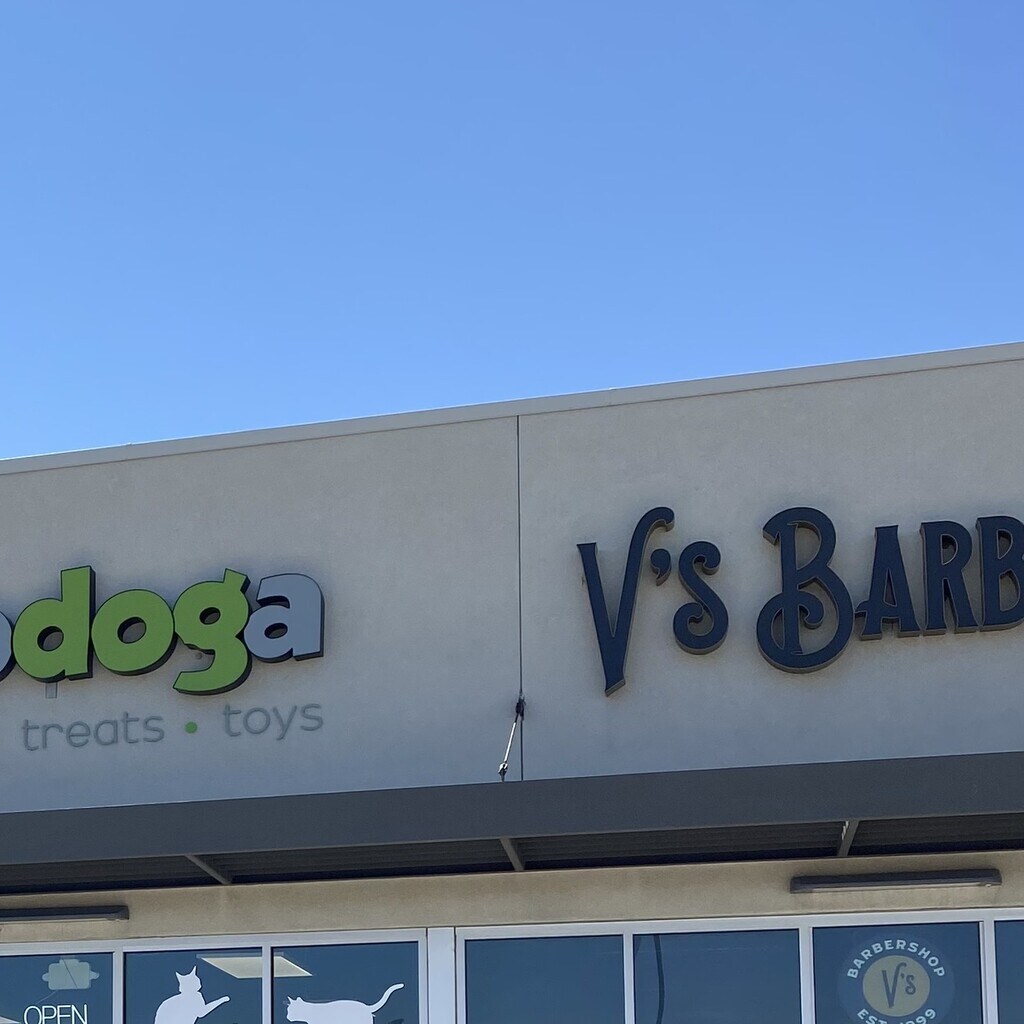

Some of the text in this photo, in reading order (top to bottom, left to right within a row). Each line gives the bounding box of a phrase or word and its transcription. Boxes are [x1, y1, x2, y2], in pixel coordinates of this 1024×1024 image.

[22, 711, 165, 751] treats
[223, 703, 324, 741] toys
[847, 939, 946, 979] BARBERSHOP
